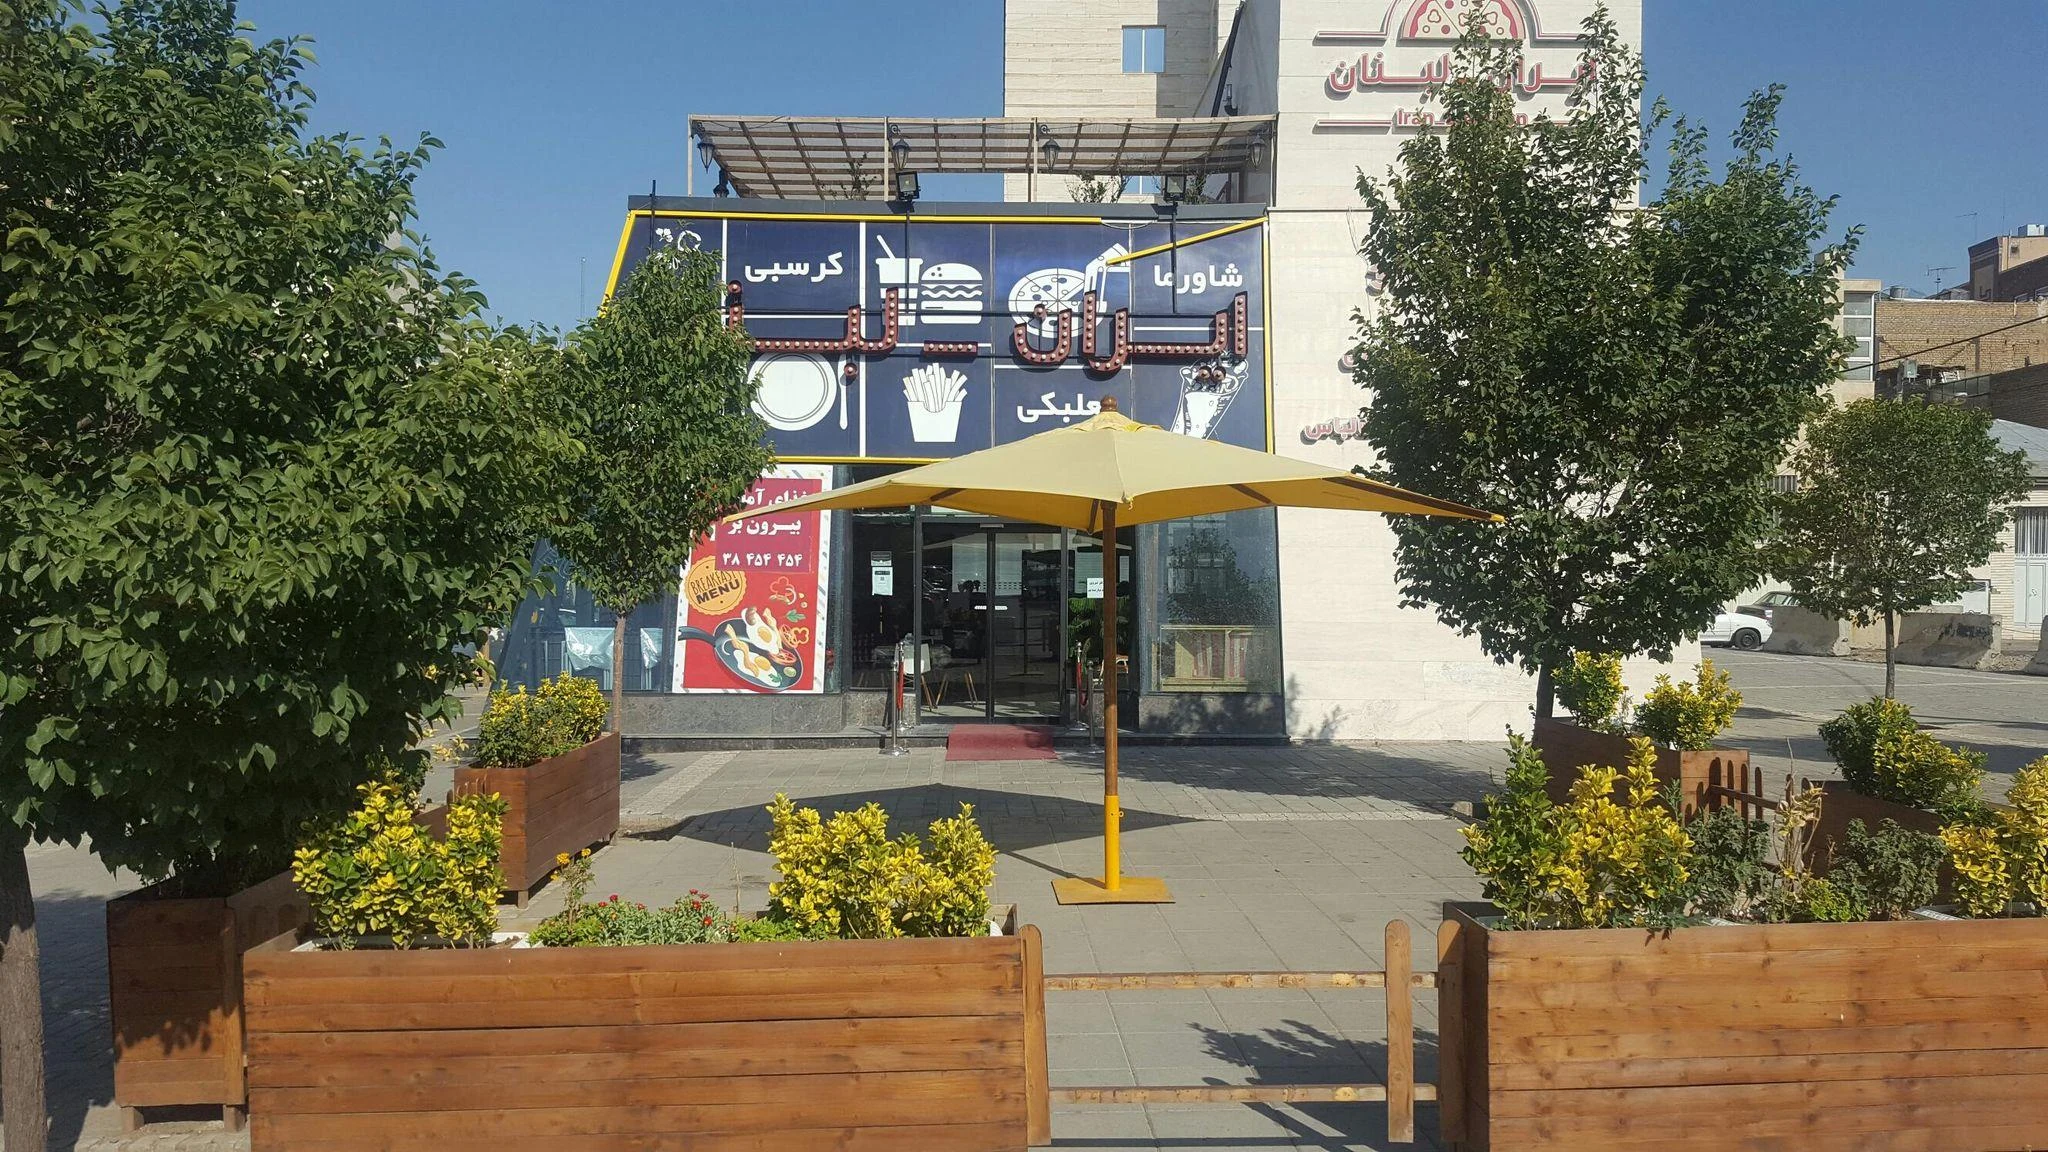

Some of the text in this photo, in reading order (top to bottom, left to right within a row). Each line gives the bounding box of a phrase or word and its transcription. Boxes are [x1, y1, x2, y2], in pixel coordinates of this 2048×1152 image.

[1329, 51, 1450, 95] لبنان
[1153, 262, 1243, 295] شاورما
[728, 280, 899, 378] لبن
[1014, 290, 1248, 384] ایران
[1016, 391, 1102, 424] علبکی
[746, 519, 802, 536] بیرون
[722, 552, 803, 568] ۳۸ ۴۵۴ ۴۵۴
[690, 570, 737, 595] BREAKFAST
[695, 578, 741, 604] MENU
